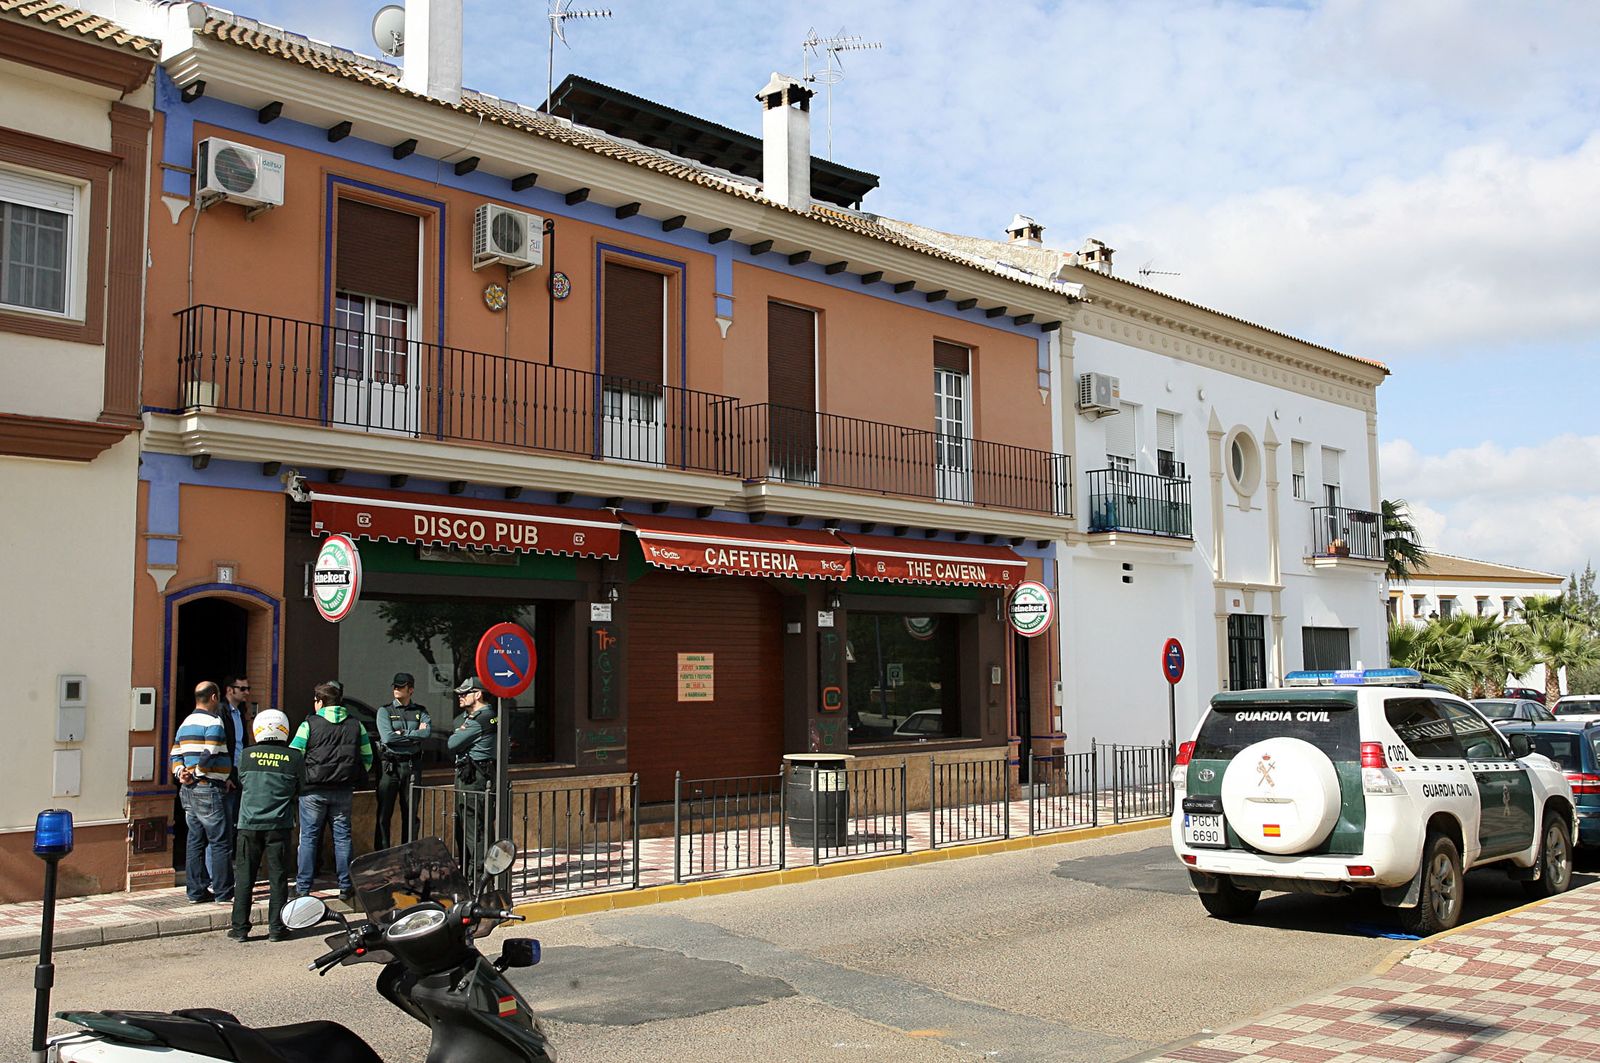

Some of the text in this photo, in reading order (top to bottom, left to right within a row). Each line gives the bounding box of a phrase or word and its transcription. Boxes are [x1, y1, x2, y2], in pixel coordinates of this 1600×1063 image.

[414, 514, 538, 545] DISCO PUB
[704, 547, 799, 571] CAFETERIA
[906, 560, 986, 581] THE CAVERN
[1011, 603, 1046, 613] Heineken
[1235, 711, 1330, 722] GUARDIA CIVIL
[250, 751, 290, 762] GUARDIA
[1393, 745, 1409, 762] 062
[257, 759, 280, 767] CIVIL
[1422, 783, 1473, 798] GUARDIA CIVIL
[1192, 815, 1219, 827] PGCN
[1193, 830, 1219, 843] 6690
